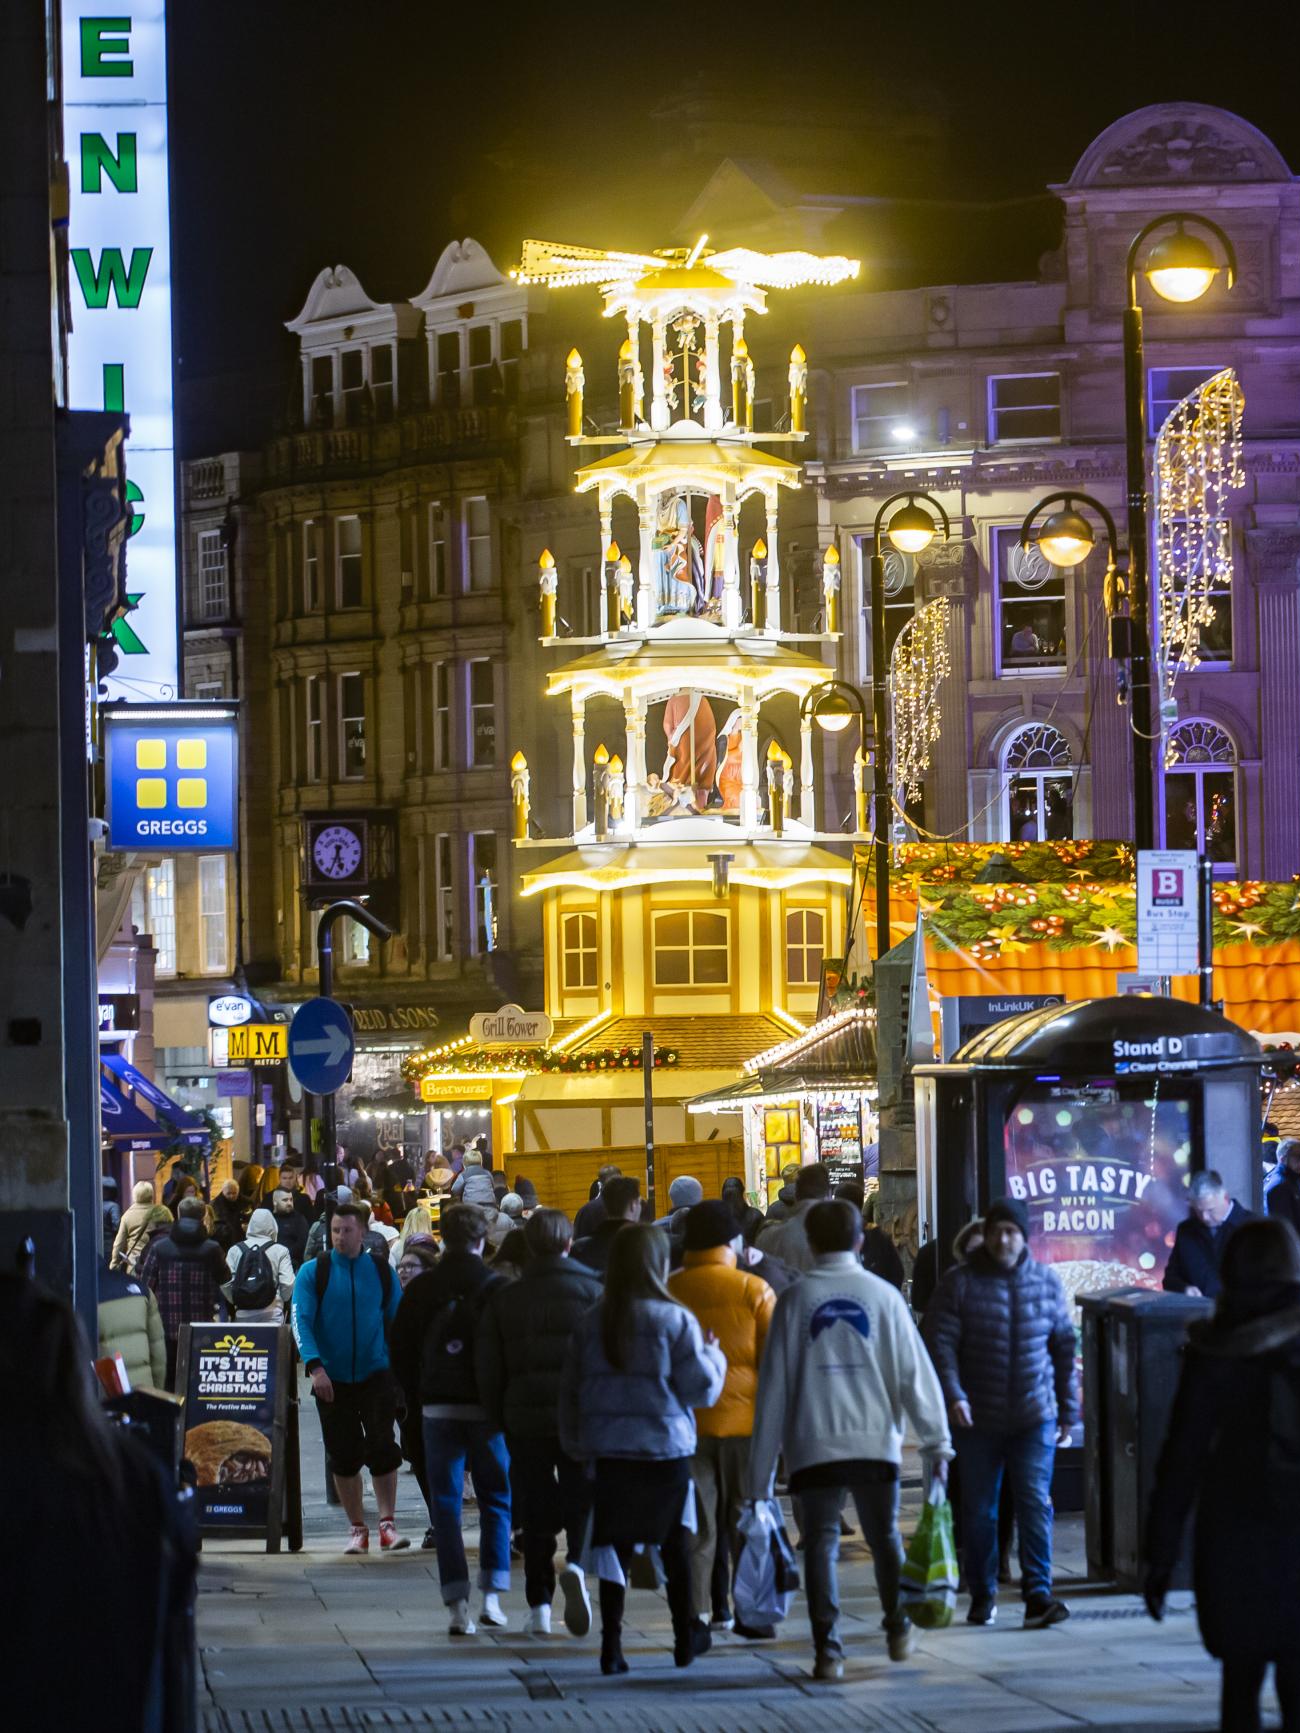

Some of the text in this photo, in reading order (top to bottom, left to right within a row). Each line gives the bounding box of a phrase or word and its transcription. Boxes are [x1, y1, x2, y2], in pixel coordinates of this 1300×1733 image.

[136, 820, 208, 835] GREGGS
[1158, 871, 1178, 895] B
[1147, 910, 1190, 919] Bus Stop
[988, 1001, 1034, 1012] InLinkUK
[397, 1006, 439, 1029] SONS
[482, 1017, 539, 1036] Grill Tower
[231, 1031, 245, 1056] M
[255, 1031, 280, 1056] M
[1113, 1036, 1183, 1057] Stand D
[254, 1058, 281, 1066] METRO
[1130, 1060, 1199, 1073] Clear Channel
[426, 1082, 488, 1096] Bratwurst
[1008, 1165, 1151, 1200] BIG TASTY
[1061, 1195, 1096, 1206] WITH
[1043, 1209, 1115, 1232] BACON
[199, 1356, 268, 1371] IT'S THE
[199, 1370, 268, 1383] TASTE OF
[198, 1383, 267, 1394] CHRISTMAS
[206, 1403, 217, 1411] The
[218, 1403, 240, 1411] Festive
